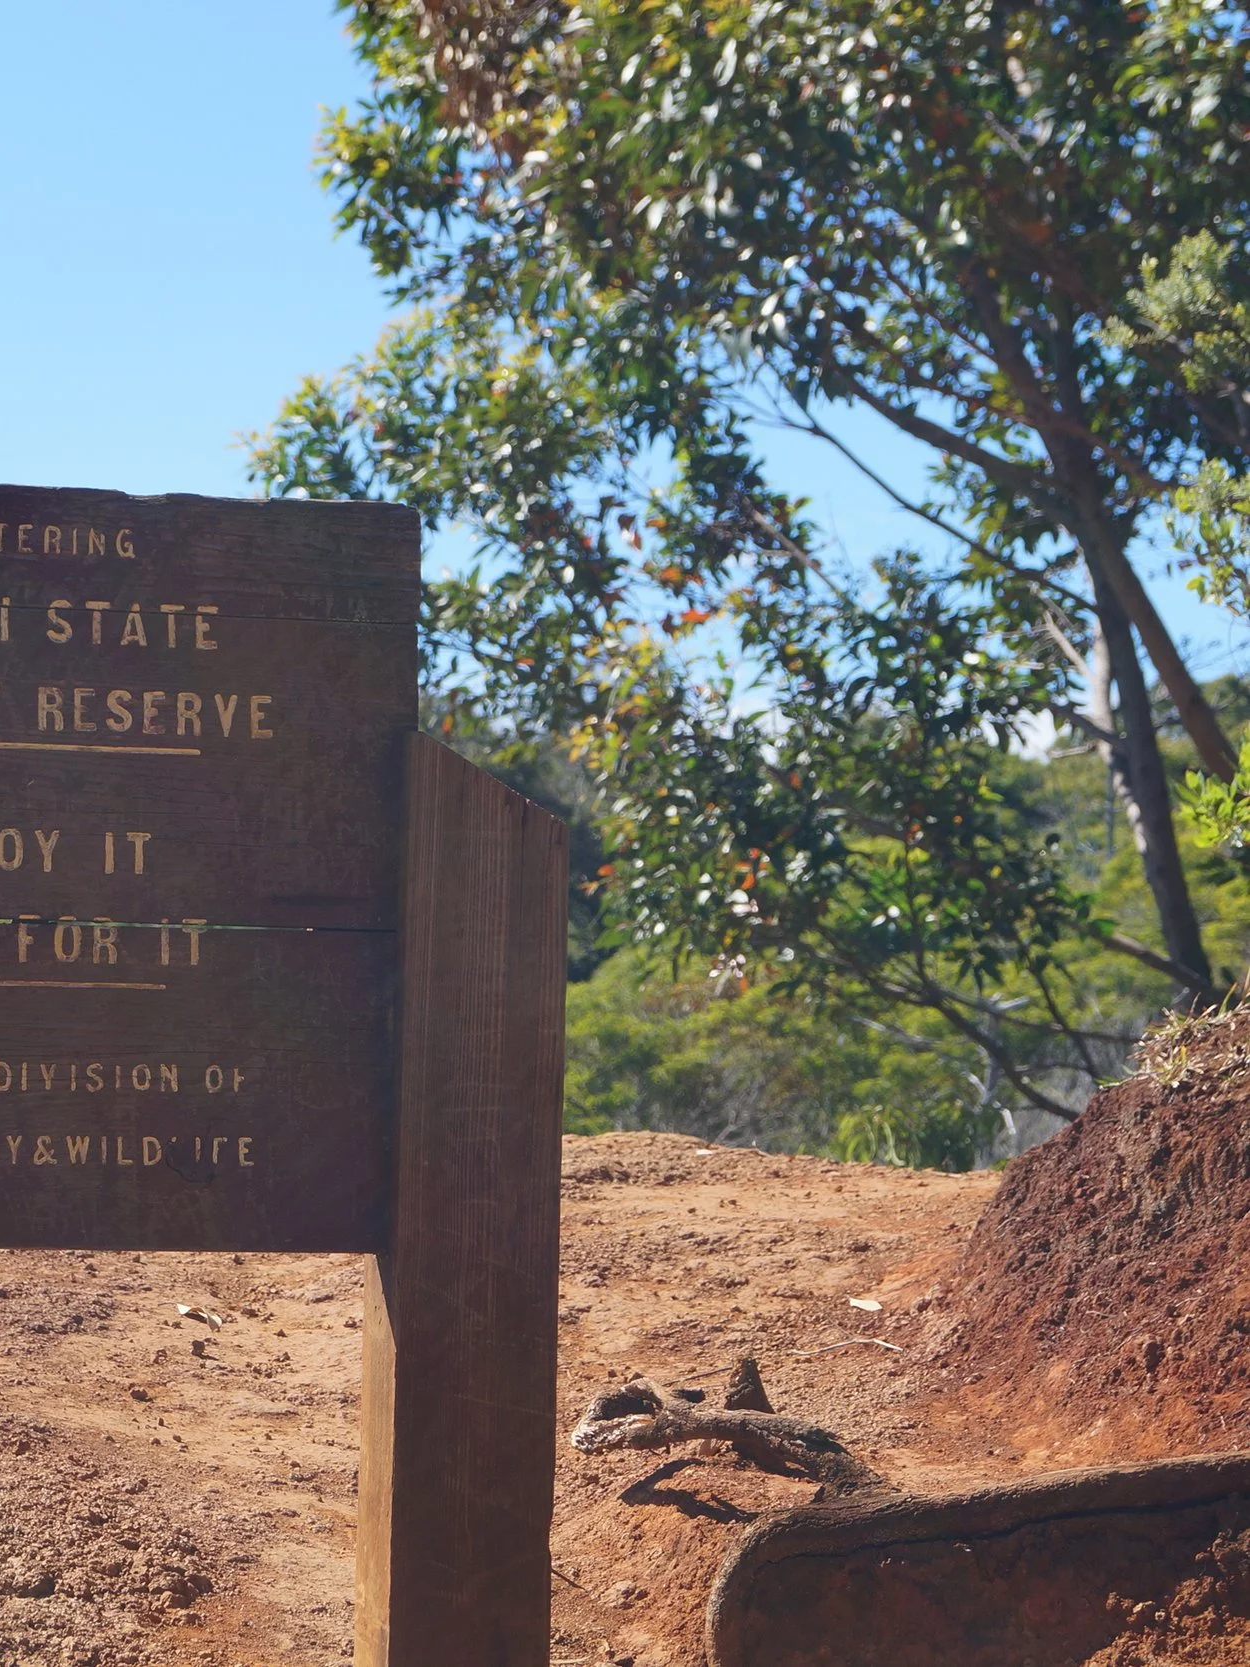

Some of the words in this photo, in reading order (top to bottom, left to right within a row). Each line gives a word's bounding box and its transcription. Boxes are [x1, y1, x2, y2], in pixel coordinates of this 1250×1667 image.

[46, 600, 220, 650] STATE
[37, 687, 275, 740] RESERVE
[104, 831, 153, 875] IT
[17, 914, 119, 965] FOR
[161, 918, 208, 966] IT
